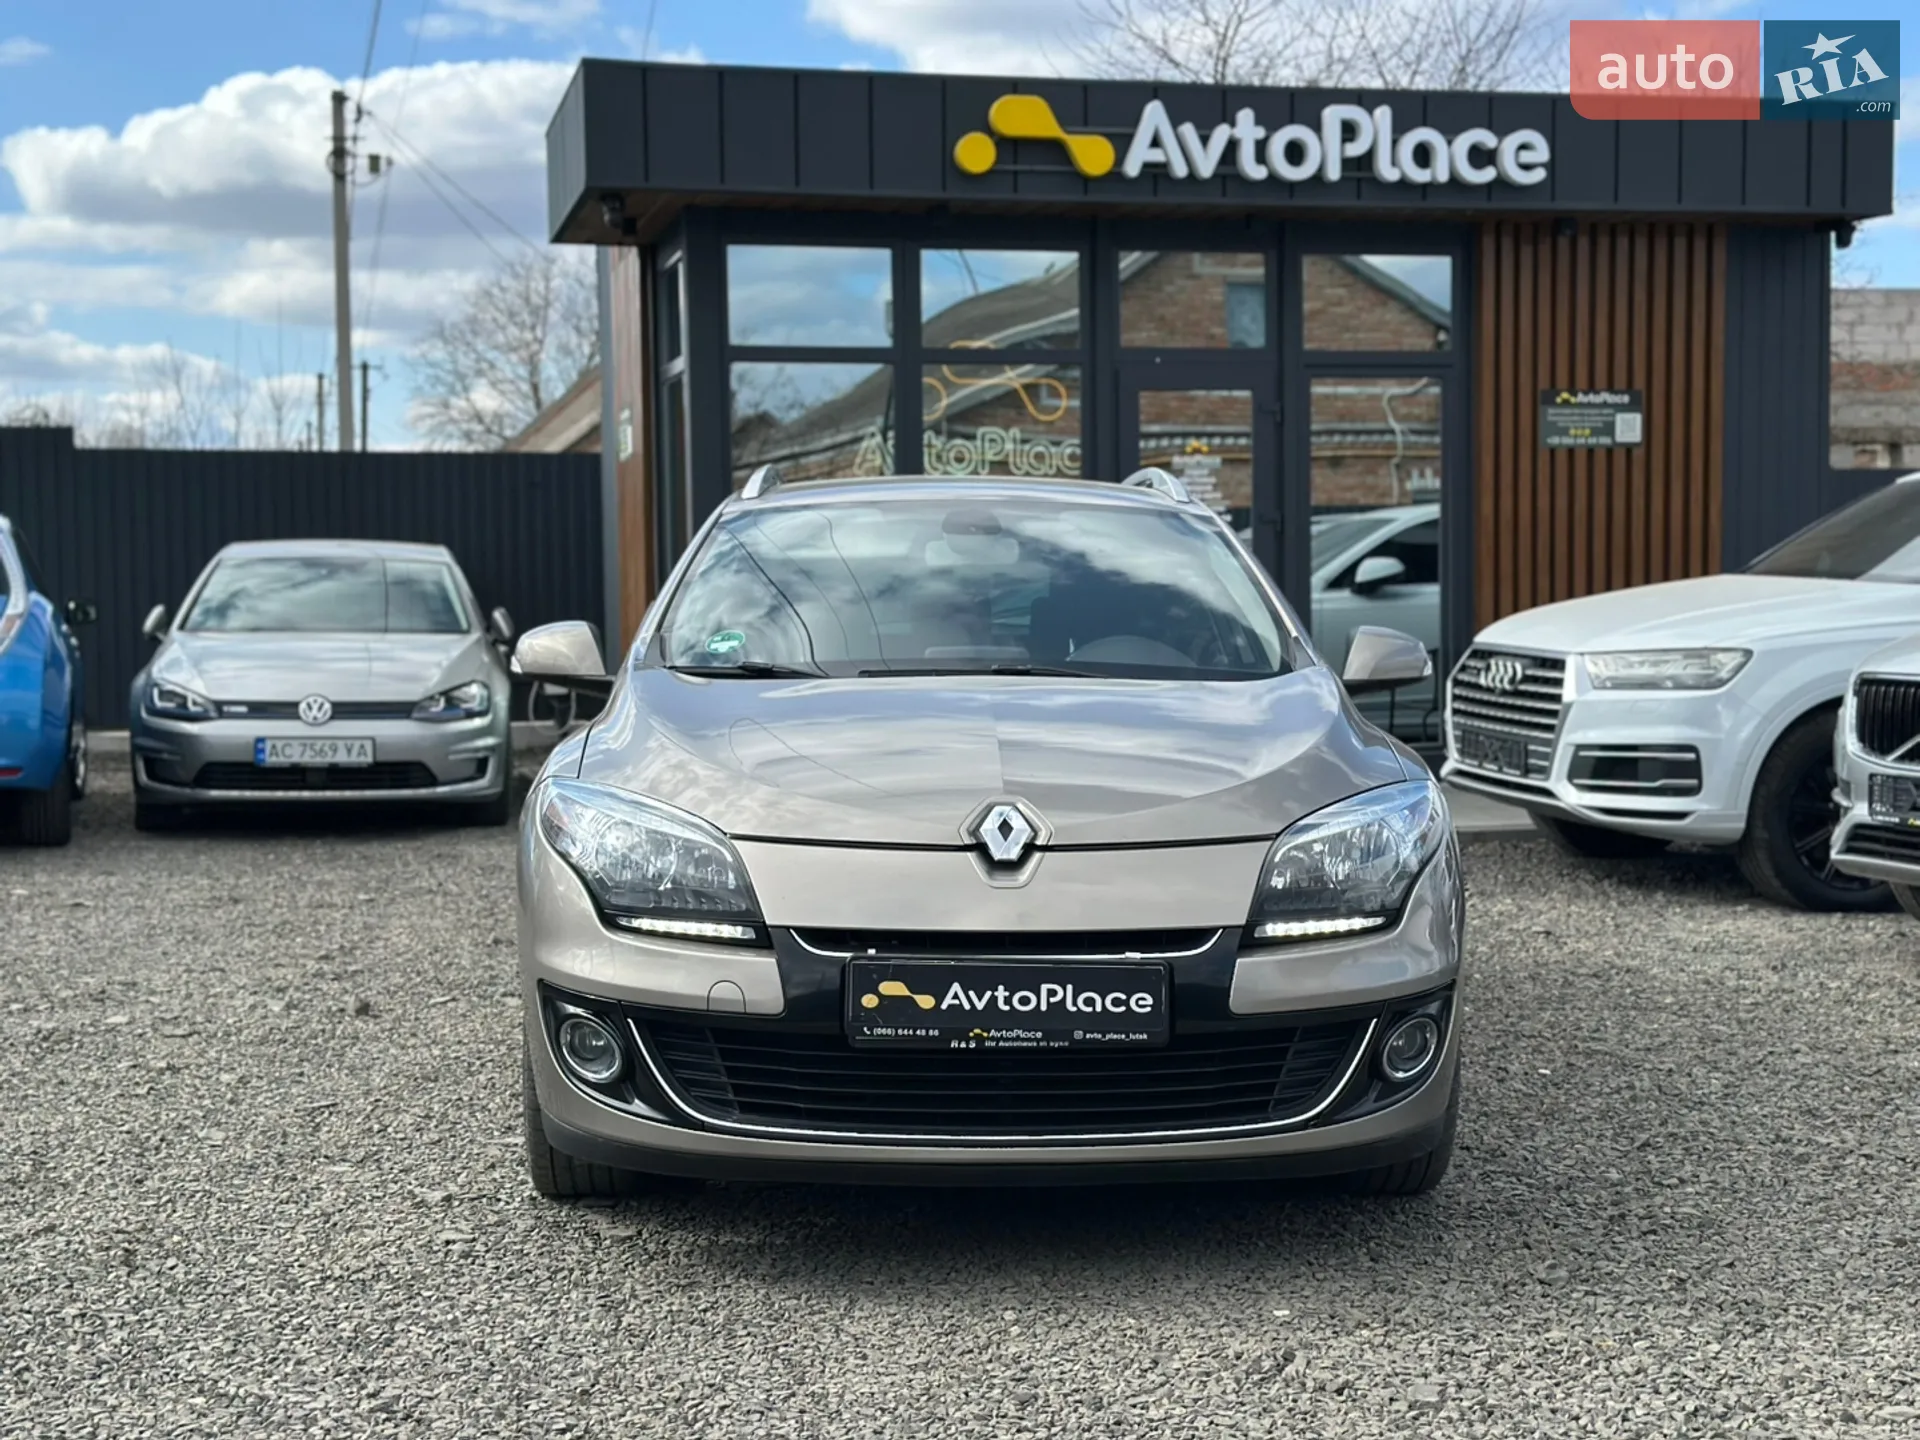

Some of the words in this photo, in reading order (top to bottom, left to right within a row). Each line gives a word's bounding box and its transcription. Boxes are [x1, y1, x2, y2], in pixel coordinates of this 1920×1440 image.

[1121, 99, 1551, 186] AvtoPlace
[268, 742, 294, 760] AC
[299, 742, 338, 760] 7569
[343, 742, 369, 760] YA
[940, 982, 1154, 1013] AvtoPlace
[988, 1028, 1043, 1039] AvtoPlace
